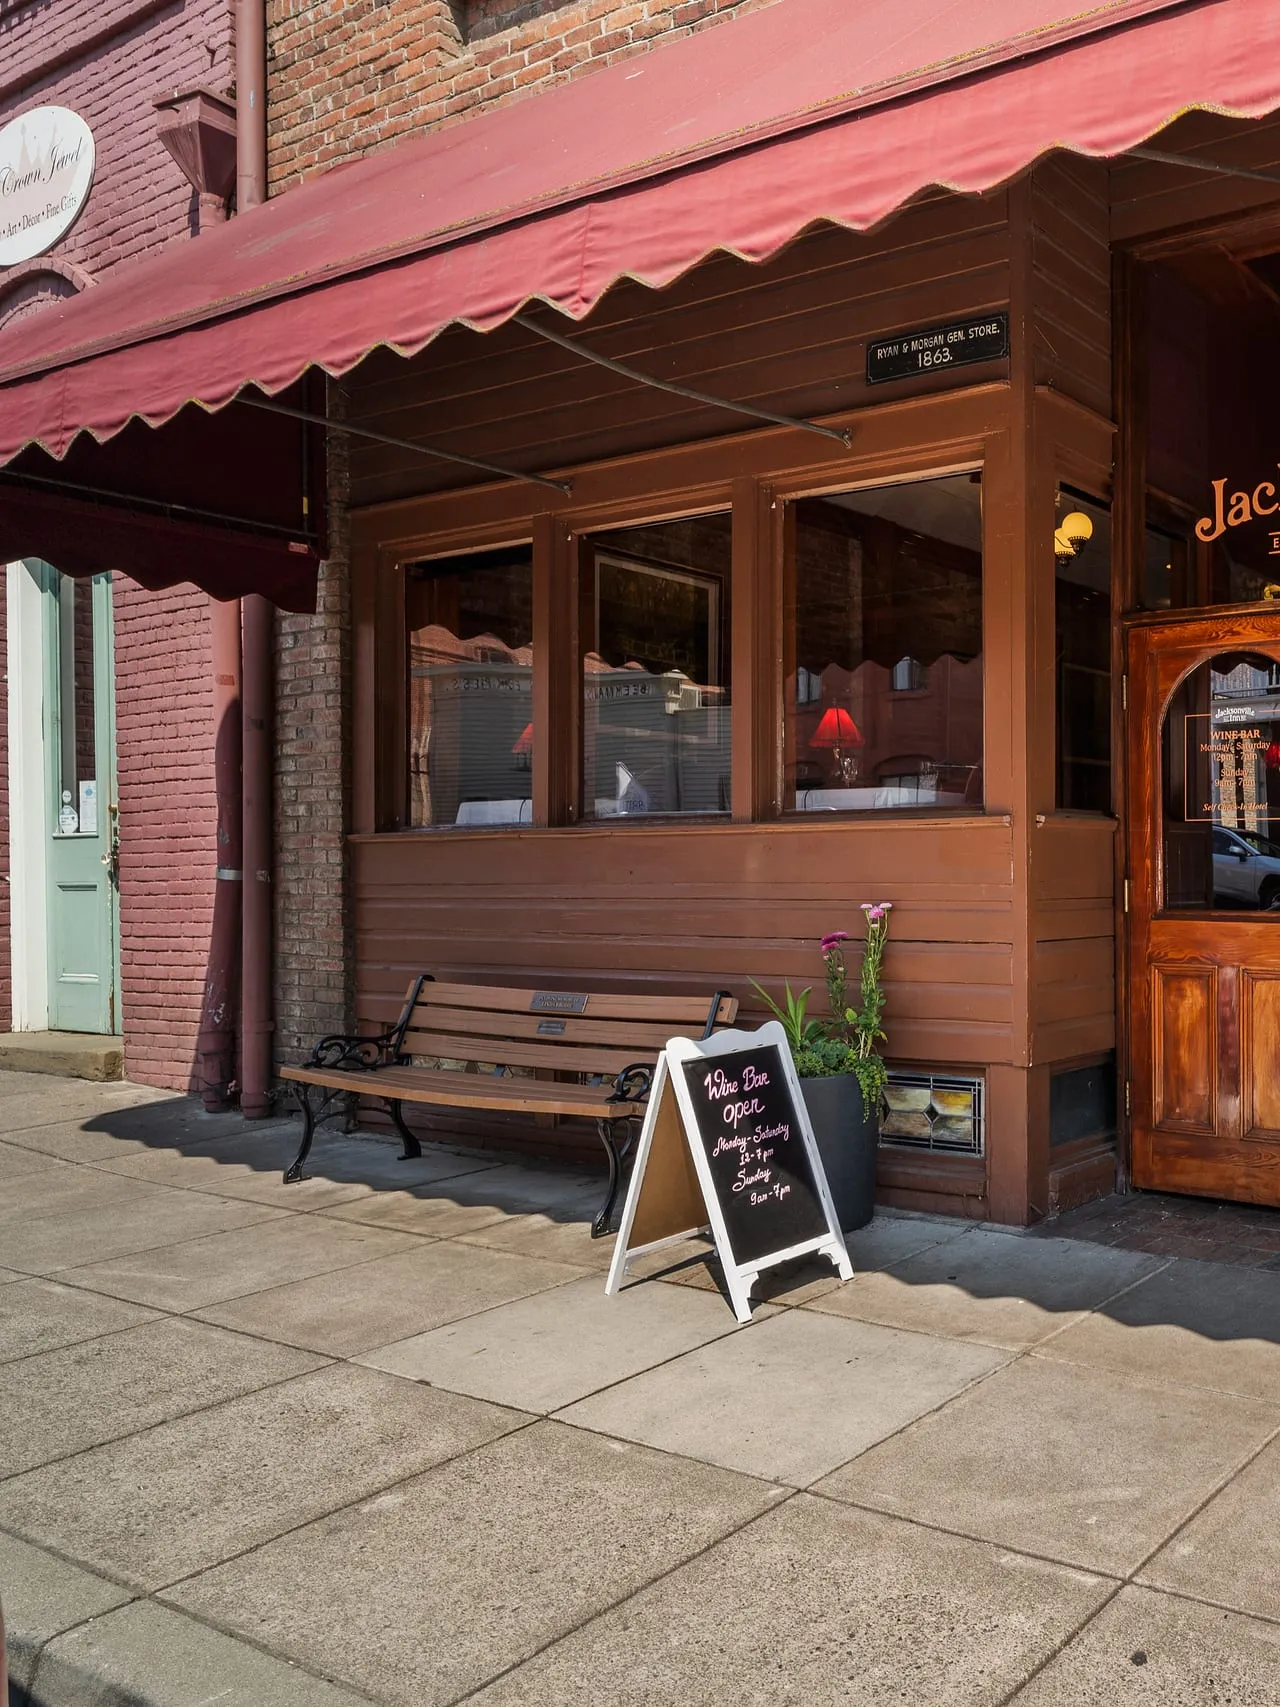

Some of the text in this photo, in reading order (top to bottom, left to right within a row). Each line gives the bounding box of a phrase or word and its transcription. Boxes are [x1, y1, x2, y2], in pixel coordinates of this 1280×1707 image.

[0, 136, 82, 197] Crown Jewel
[45, 203, 60, 219] Fine
[877, 323, 1000, 360] RYAN & MORGAN GEN. STORE.
[1215, 707, 1254, 719] Jacksonville
[1210, 729, 1261, 740] WINE BAR
[1200, 741, 1271, 752] Monday Saturday
[1220, 768, 1250, 778] Sunday
[704, 1065, 770, 1101] Wine Bar
[732, 1167, 772, 1192] Sunday
